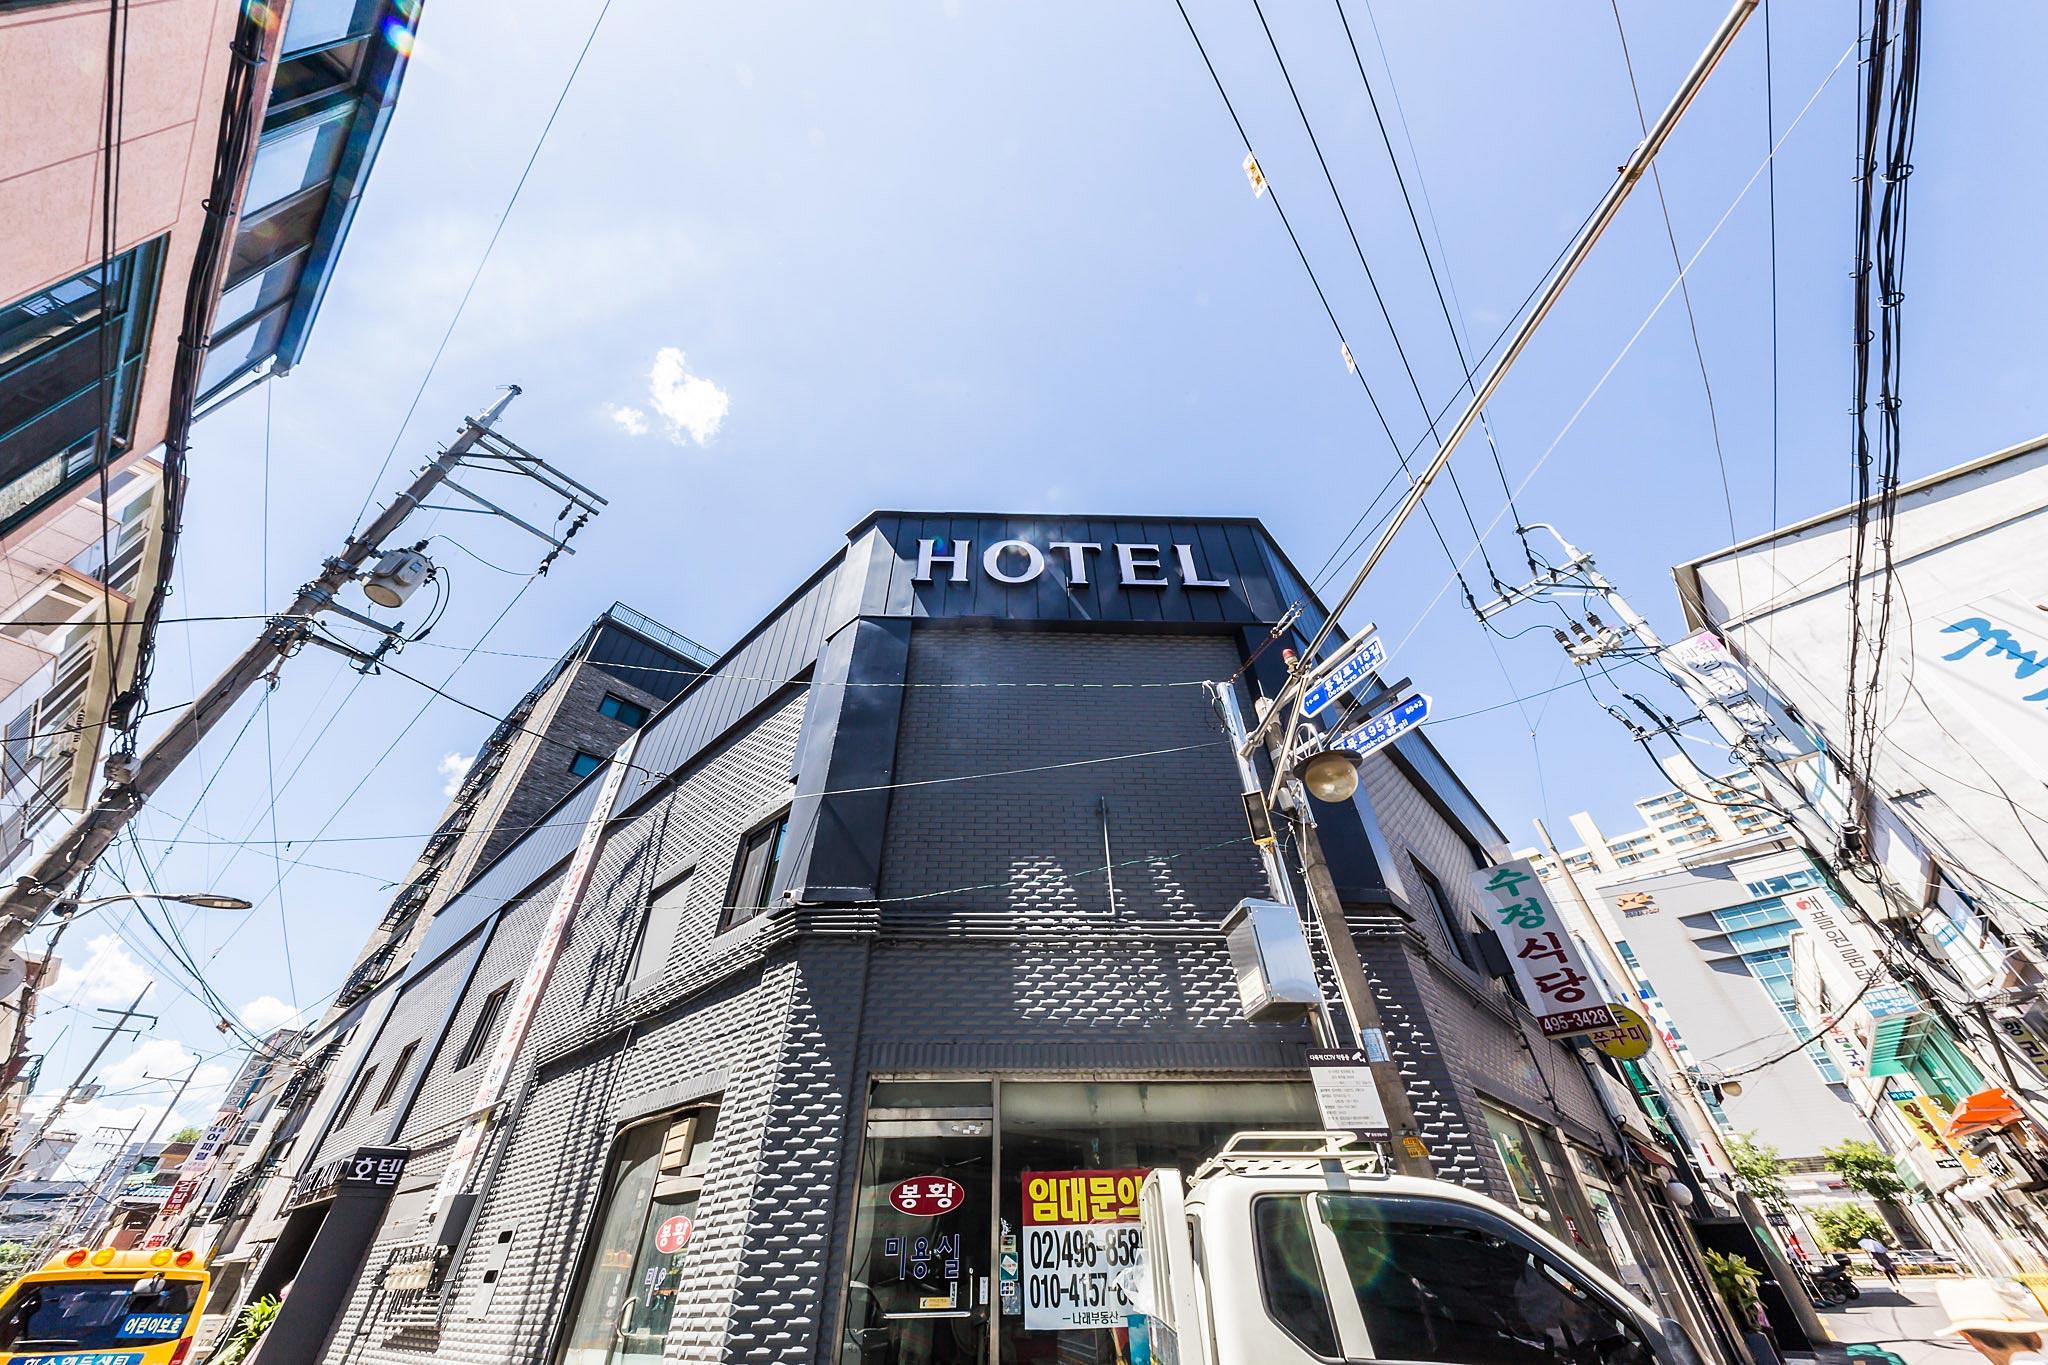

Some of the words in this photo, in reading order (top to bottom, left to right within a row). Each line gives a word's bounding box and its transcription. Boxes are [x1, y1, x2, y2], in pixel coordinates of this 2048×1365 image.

[913, 538, 1230, 588] HOTEL
[1324, 643, 1380, 690] 동일로118길
[1485, 867, 1588, 1003] 수정식당
[1543, 1008, 1608, 1033] 495-3428
[1592, 1024, 1648, 1048] 쭈꾸미
[347, 1157, 405, 1185] 호텔
[898, 1182, 956, 1209] 봉황
[1028, 1175, 1142, 1223] 임대문의
[660, 1220, 690, 1247] 봉황
[884, 1233, 961, 1280] 미용실
[1030, 1228, 1143, 1270] 02)496-858
[124, 1316, 183, 1335] 어린이보호
[1073, 1311, 1119, 1325] 나래부동산
